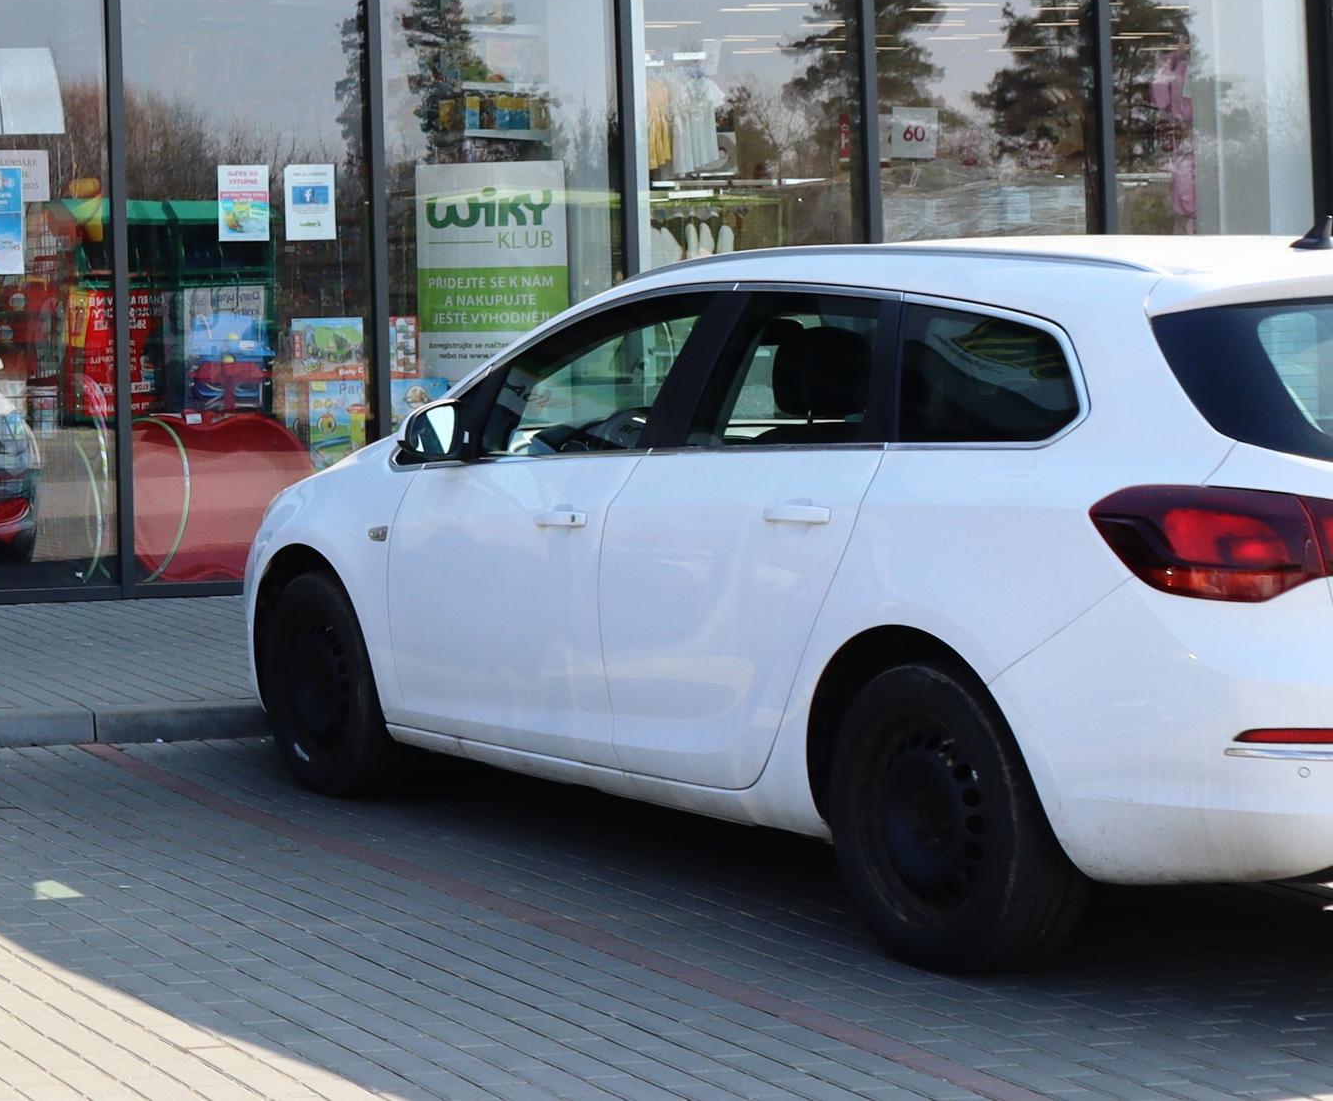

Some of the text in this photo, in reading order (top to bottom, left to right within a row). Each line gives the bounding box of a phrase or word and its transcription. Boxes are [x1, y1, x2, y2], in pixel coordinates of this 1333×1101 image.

[902, 125, 926, 142] 60
[498, 230, 553, 249] KLUB
[429, 274, 554, 289] PŘIDEJTE SE K NÁM
[445, 294, 536, 307] A NAKUPUJTE
[433, 311, 468, 325] JEŠTĚ
